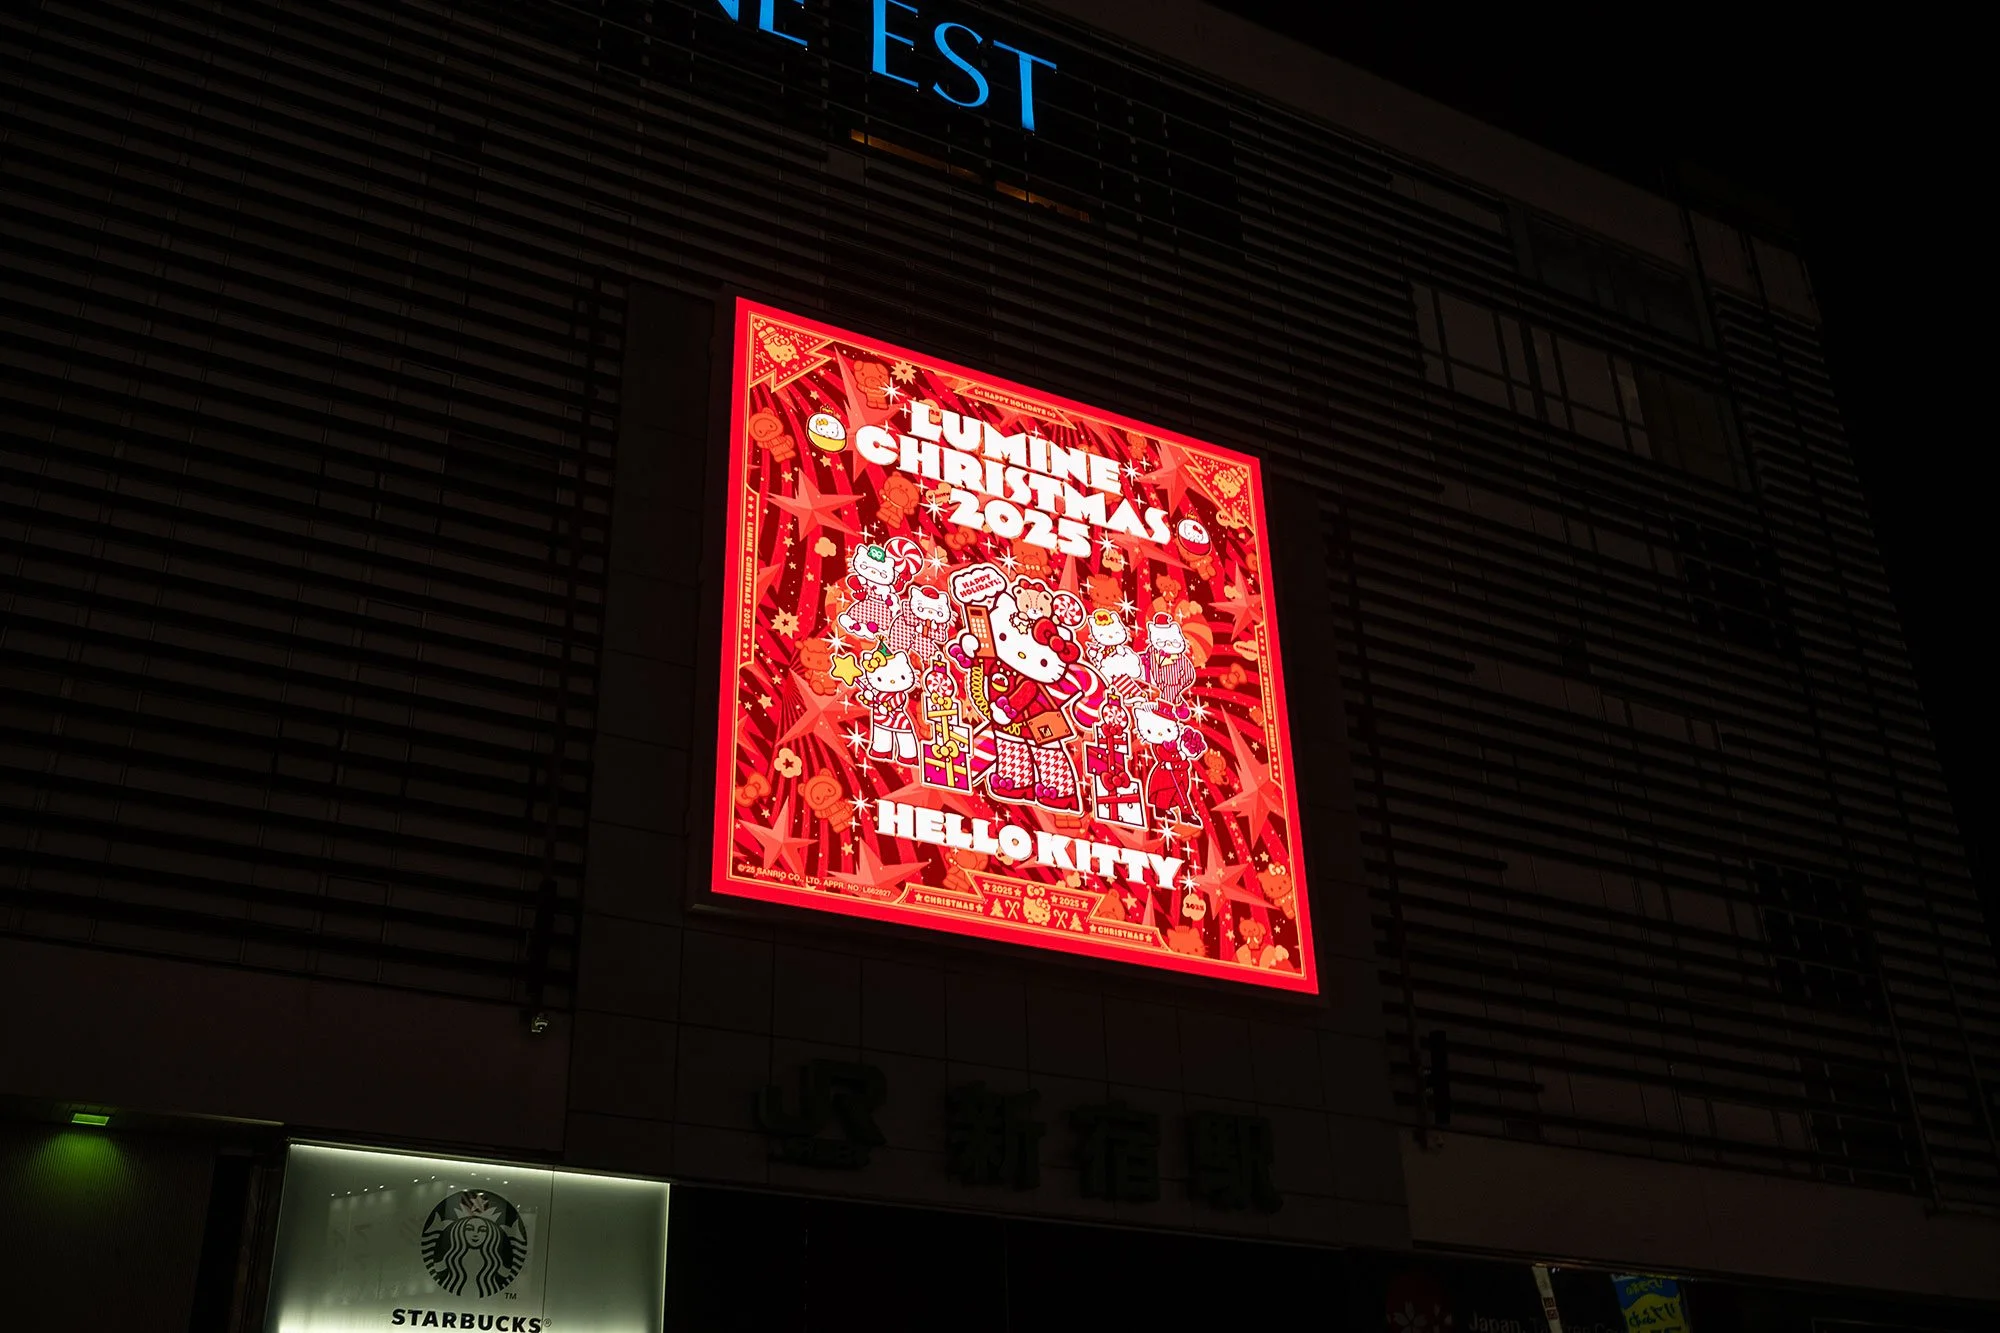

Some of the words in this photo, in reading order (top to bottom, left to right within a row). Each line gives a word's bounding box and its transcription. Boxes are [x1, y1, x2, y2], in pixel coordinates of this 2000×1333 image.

[872, 0, 1057, 131] EST
[984, 391, 1009, 404] HAPPY
[907, 400, 1123, 496] LUMINE
[855, 424, 1171, 545] CHRISTMAS
[948, 488, 1092, 558] 2025
[962, 574, 991, 589] HAPPY
[875, 799, 1032, 861] HELLO
[1034, 830, 1185, 890] KITTY
[756, 866, 787, 880] SANRIO
[991, 884, 1013, 896] 2025
[923, 894, 974, 912] CHRISTMAS
[1059, 896, 1081, 908] 2025
[1098, 926, 1144, 942] CHRISTMAS
[944, 1081, 1282, 1213] 新宿駅
